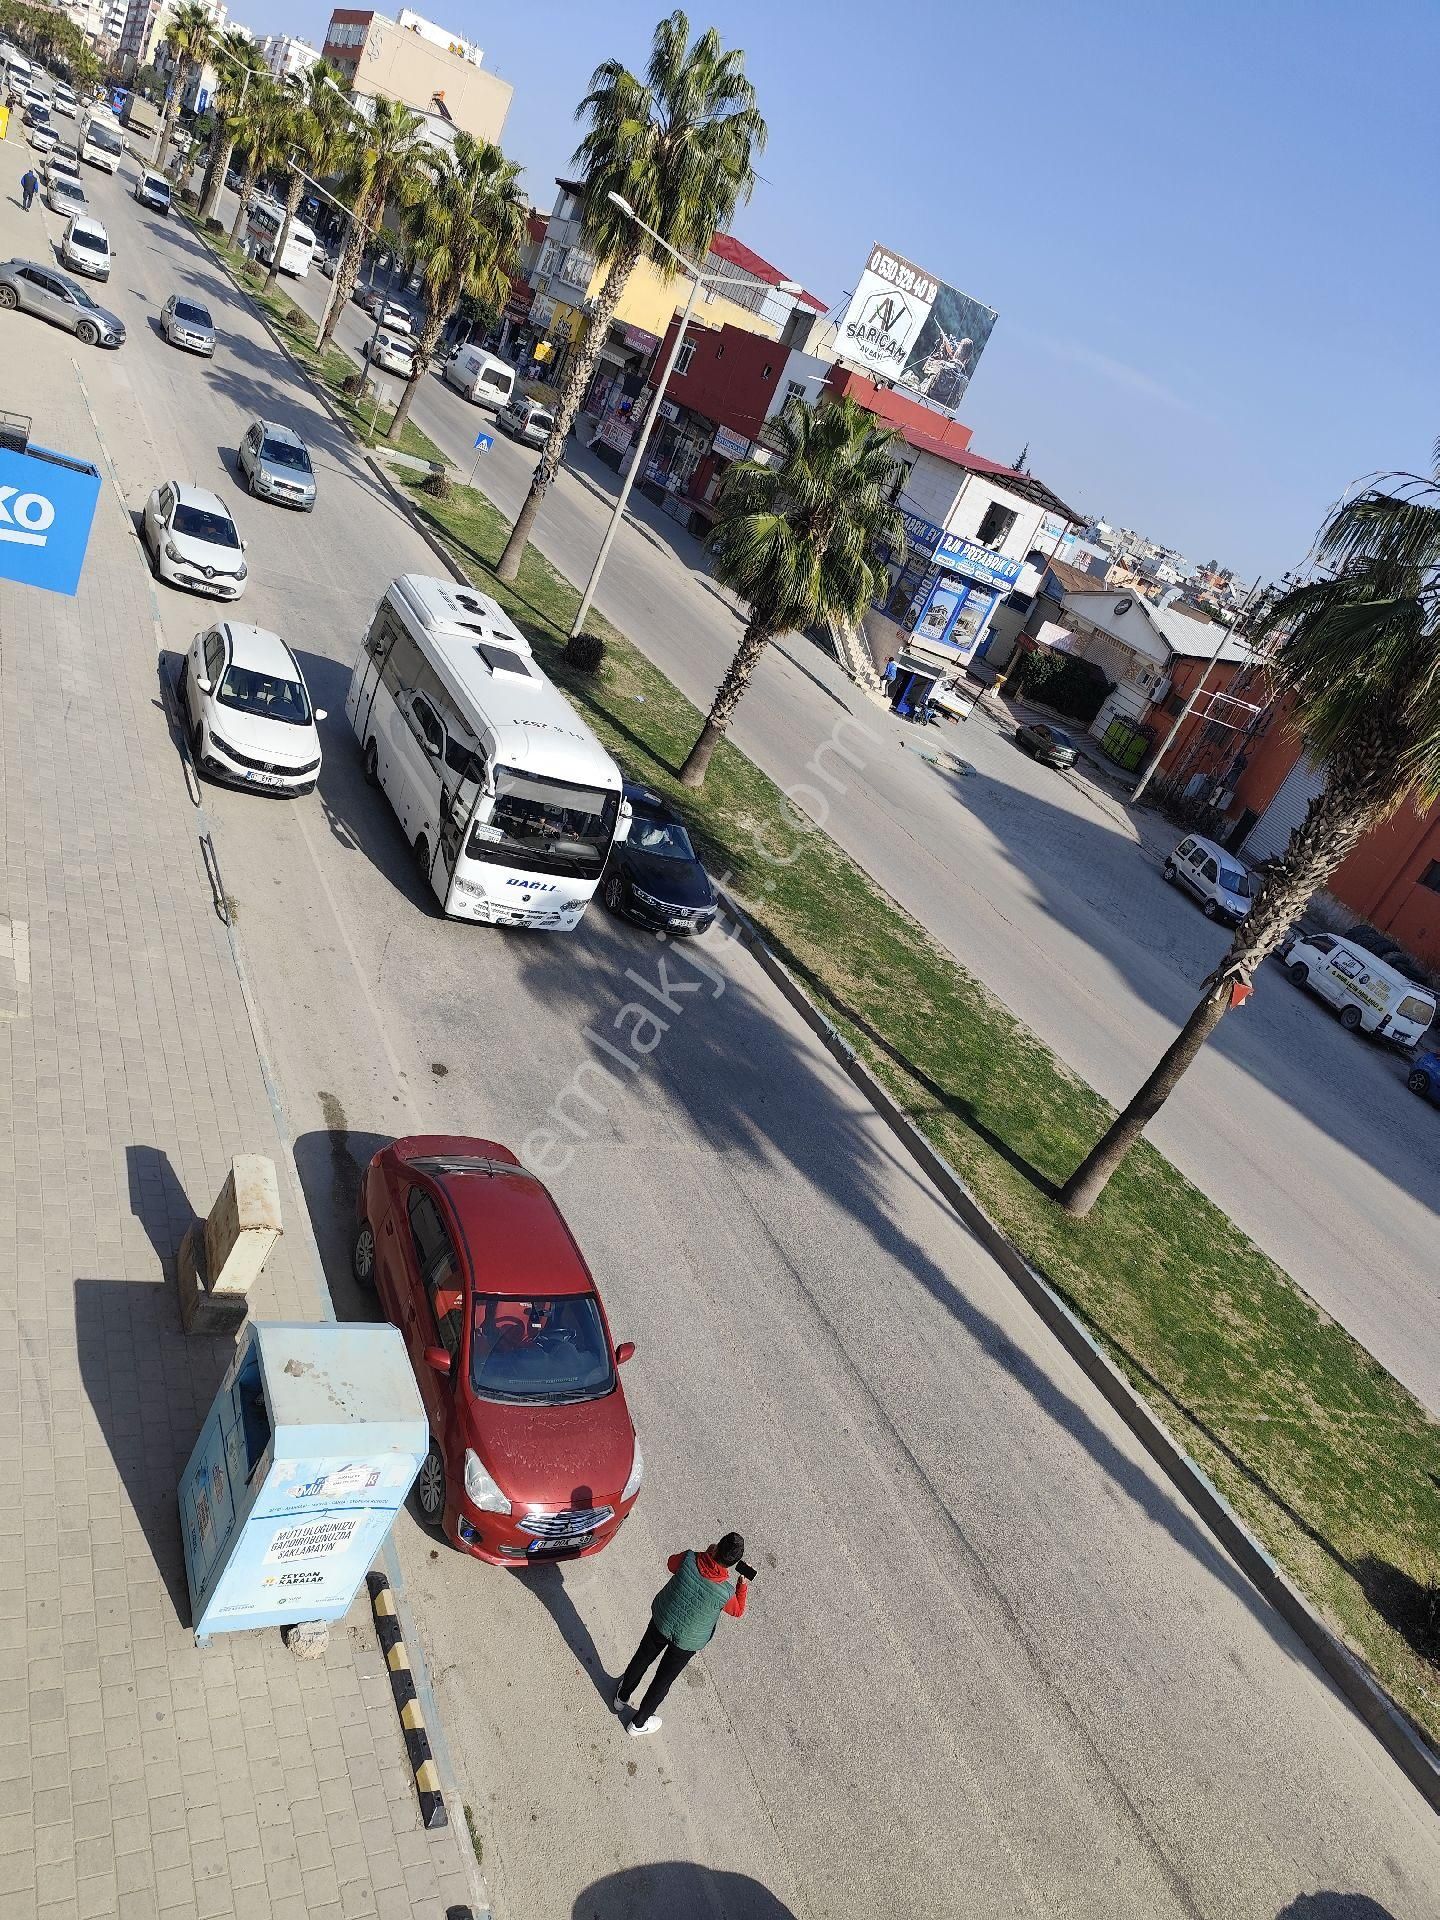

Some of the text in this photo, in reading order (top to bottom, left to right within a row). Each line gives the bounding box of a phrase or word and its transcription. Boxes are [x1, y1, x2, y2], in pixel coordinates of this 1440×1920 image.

[871, 251, 881, 270] 0
[505, 876, 557, 893] DAĞLI
[278, 1576, 324, 1585] KARALAR
[281, 1571, 320, 1580] ZEYDAN
